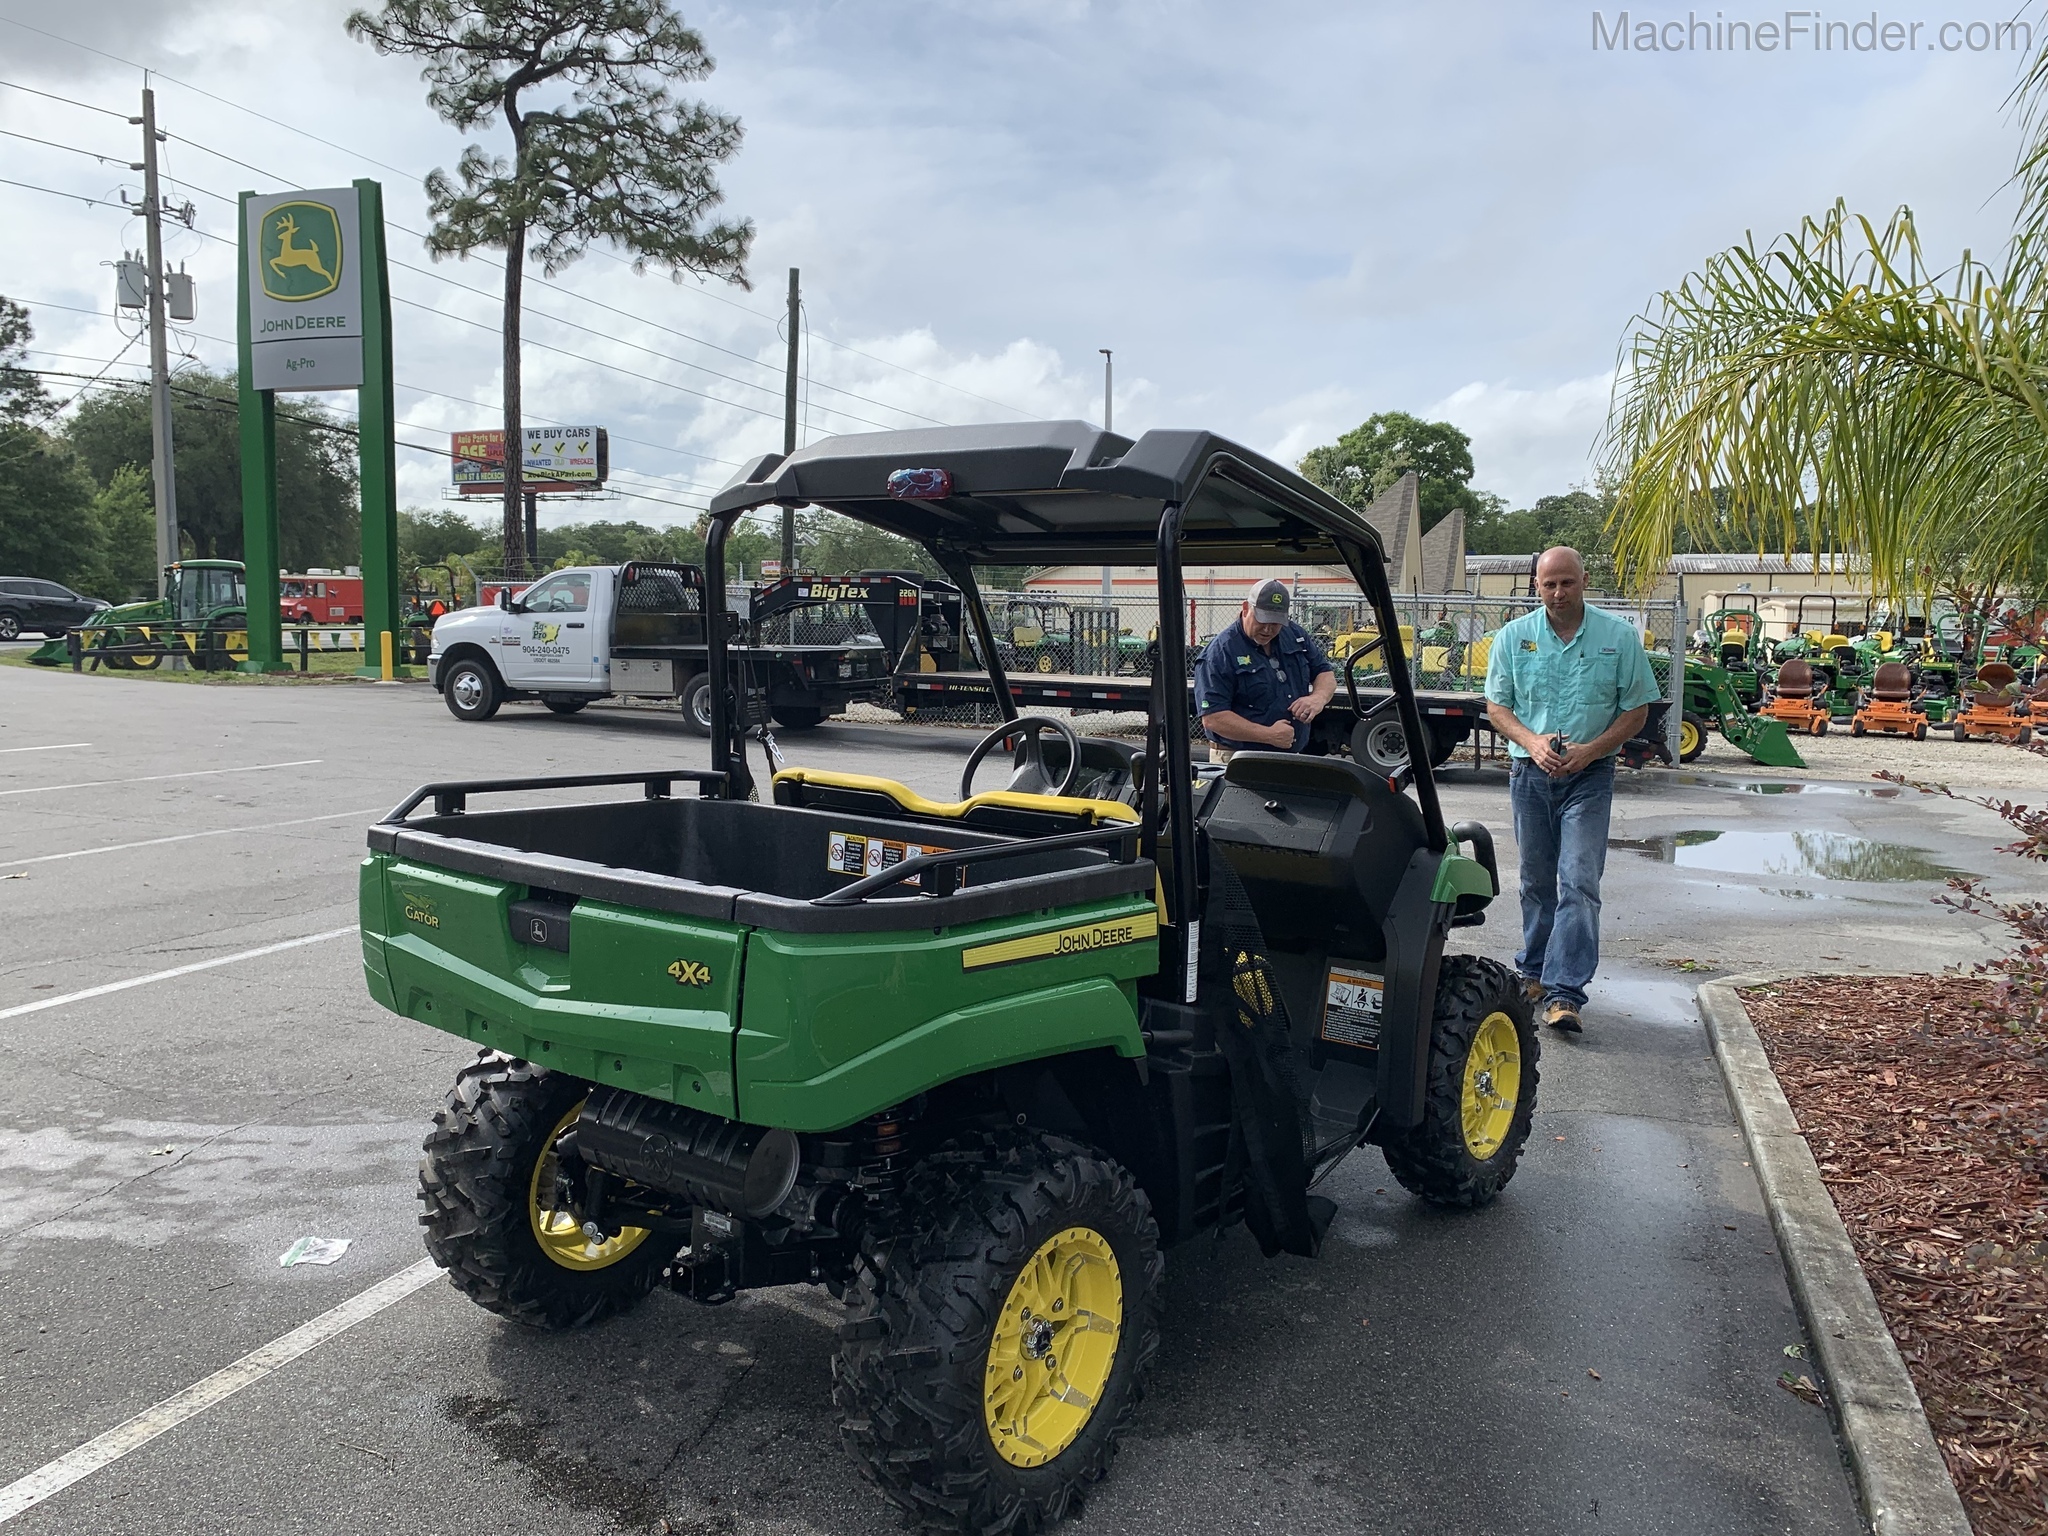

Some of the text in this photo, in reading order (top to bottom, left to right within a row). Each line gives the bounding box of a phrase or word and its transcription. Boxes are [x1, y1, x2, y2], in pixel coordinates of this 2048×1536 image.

[260, 315, 346, 333] JOHN DEERE
[286, 357, 315, 371] Ag-Pro
[458, 434, 471, 444] Auto
[472, 433, 489, 443] Parts
[490, 432, 499, 442] for
[527, 428, 591, 439] WE BUY CARS
[460, 444, 487, 458] ACE
[524, 458, 552, 466] UNWANTED
[569, 457, 595, 465] WRECKED
[899, 597, 917, 606] HD
[532, 630, 547, 639] Pro
[522, 645, 570, 654] 904-240-0475
[948, 684, 992, 693] HI-TENSILE
[405, 905, 439, 928] GATOR
[1054, 926, 1133, 953] JOHN DEERE
[667, 959, 711, 985] 4X4
[1352, 979, 1372, 987] WARNING
